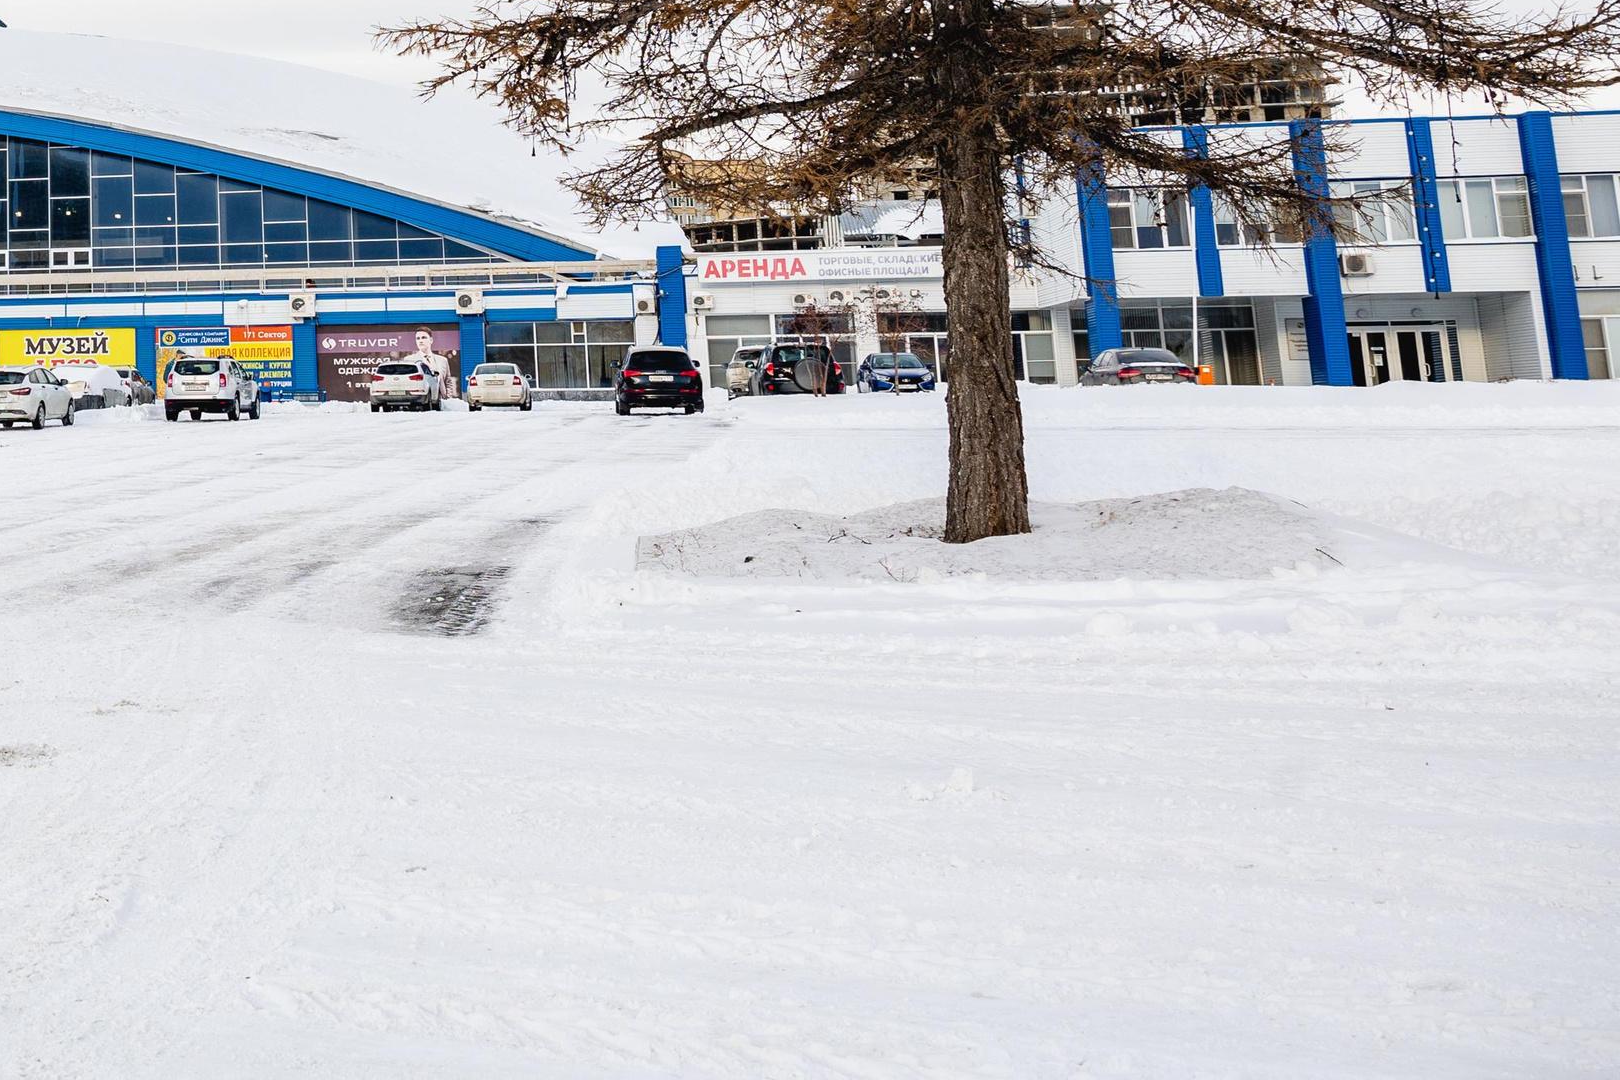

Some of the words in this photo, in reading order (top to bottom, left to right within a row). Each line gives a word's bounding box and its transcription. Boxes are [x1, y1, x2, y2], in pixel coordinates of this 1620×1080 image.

[704, 257, 807, 280] АРЕНДА
[819, 255, 876, 266] ТОРГОВЫЕ,
[818, 266, 871, 277] ОФИСНЫЕ
[873, 265, 929, 277] ПЛОЩАДИ
[243, 331, 256, 339] 171
[257, 331, 288, 339] Сектор
[25, 331, 109, 355] МУЗЕЙ
[338, 338, 399, 348] TRUVOR
[209, 347, 237, 358] НОВАЯ
[239, 346, 291, 358] КОЛЛЕКЦИЯ
[338, 367, 377, 376] ОДЕЖД
